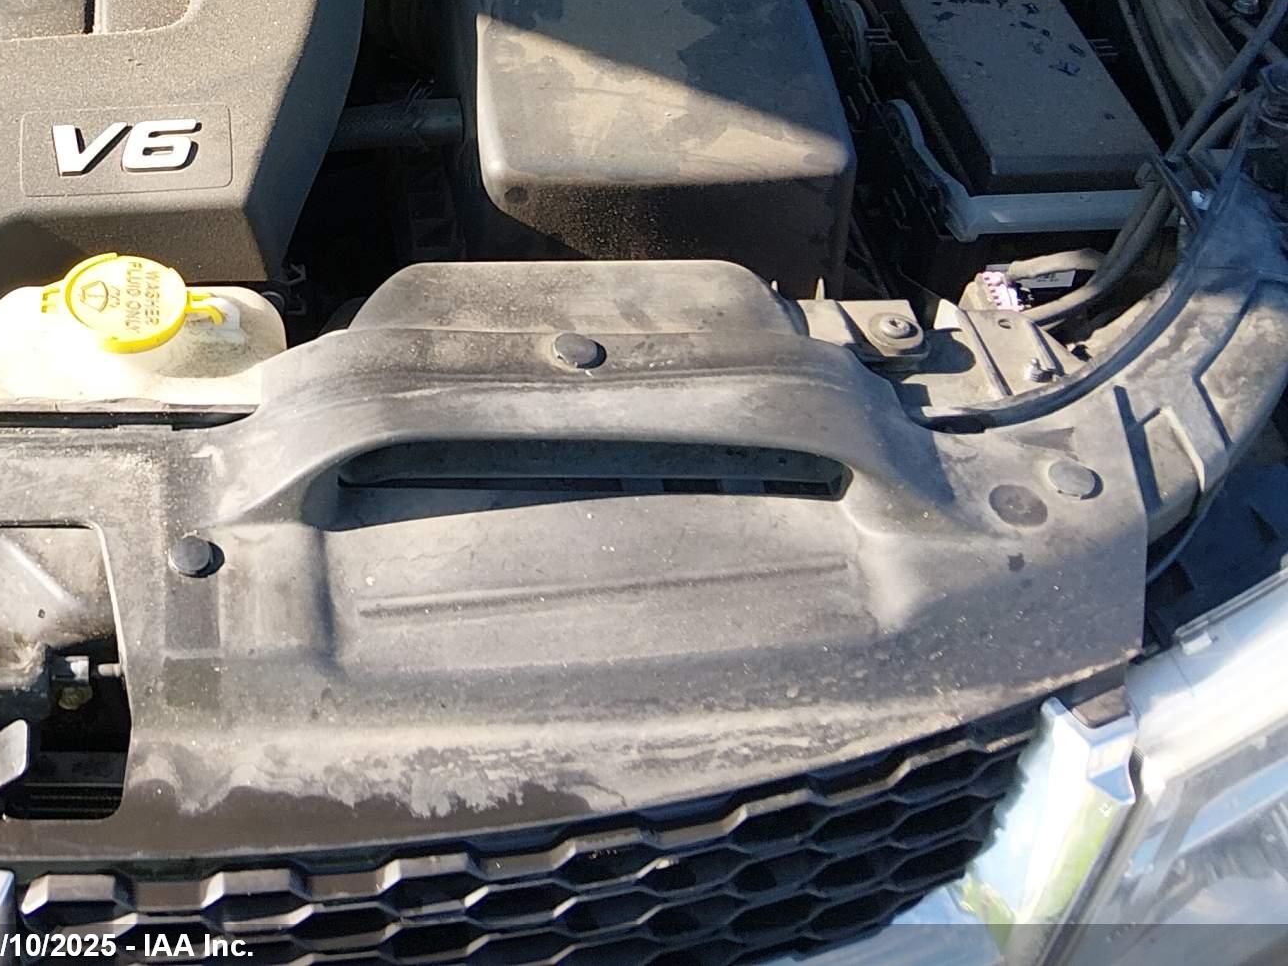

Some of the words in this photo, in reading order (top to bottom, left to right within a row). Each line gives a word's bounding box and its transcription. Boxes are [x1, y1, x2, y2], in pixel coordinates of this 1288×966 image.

[53, 118, 202, 176] V6
[125, 261, 143, 298] FLUID
[144, 269, 161, 326] WASHER
[124, 299, 142, 334] ONLY
